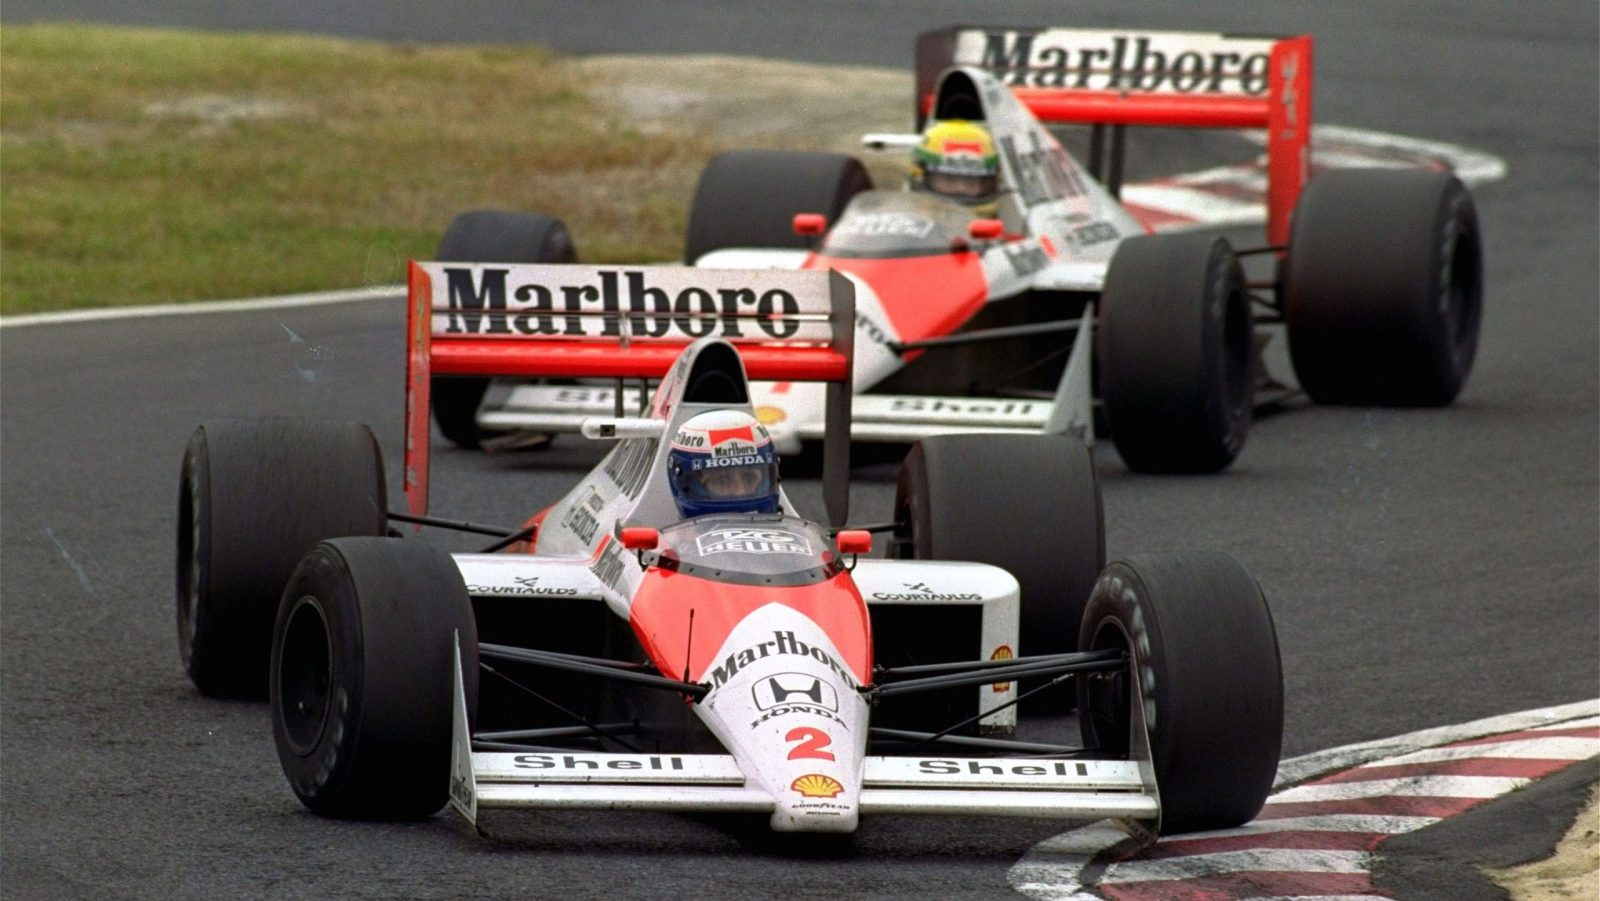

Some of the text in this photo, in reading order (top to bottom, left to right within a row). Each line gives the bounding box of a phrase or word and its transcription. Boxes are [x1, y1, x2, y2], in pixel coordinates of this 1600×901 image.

[983, 32, 1269, 95] Marlboro
[443, 267, 800, 338] Marlboro
[890, 400, 1033, 415] Shell
[714, 442, 755, 458] Marlboro
[705, 455, 765, 468] HONDA
[711, 530, 795, 542] TAG
[702, 540, 807, 553] HEUER
[872, 592, 983, 601] COURTAULDS
[711, 630, 857, 691] Marlboro
[751, 706, 850, 731] HONDA
[784, 726, 836, 762] 2
[513, 754, 684, 770] Shell
[918, 759, 1089, 777] Shell
